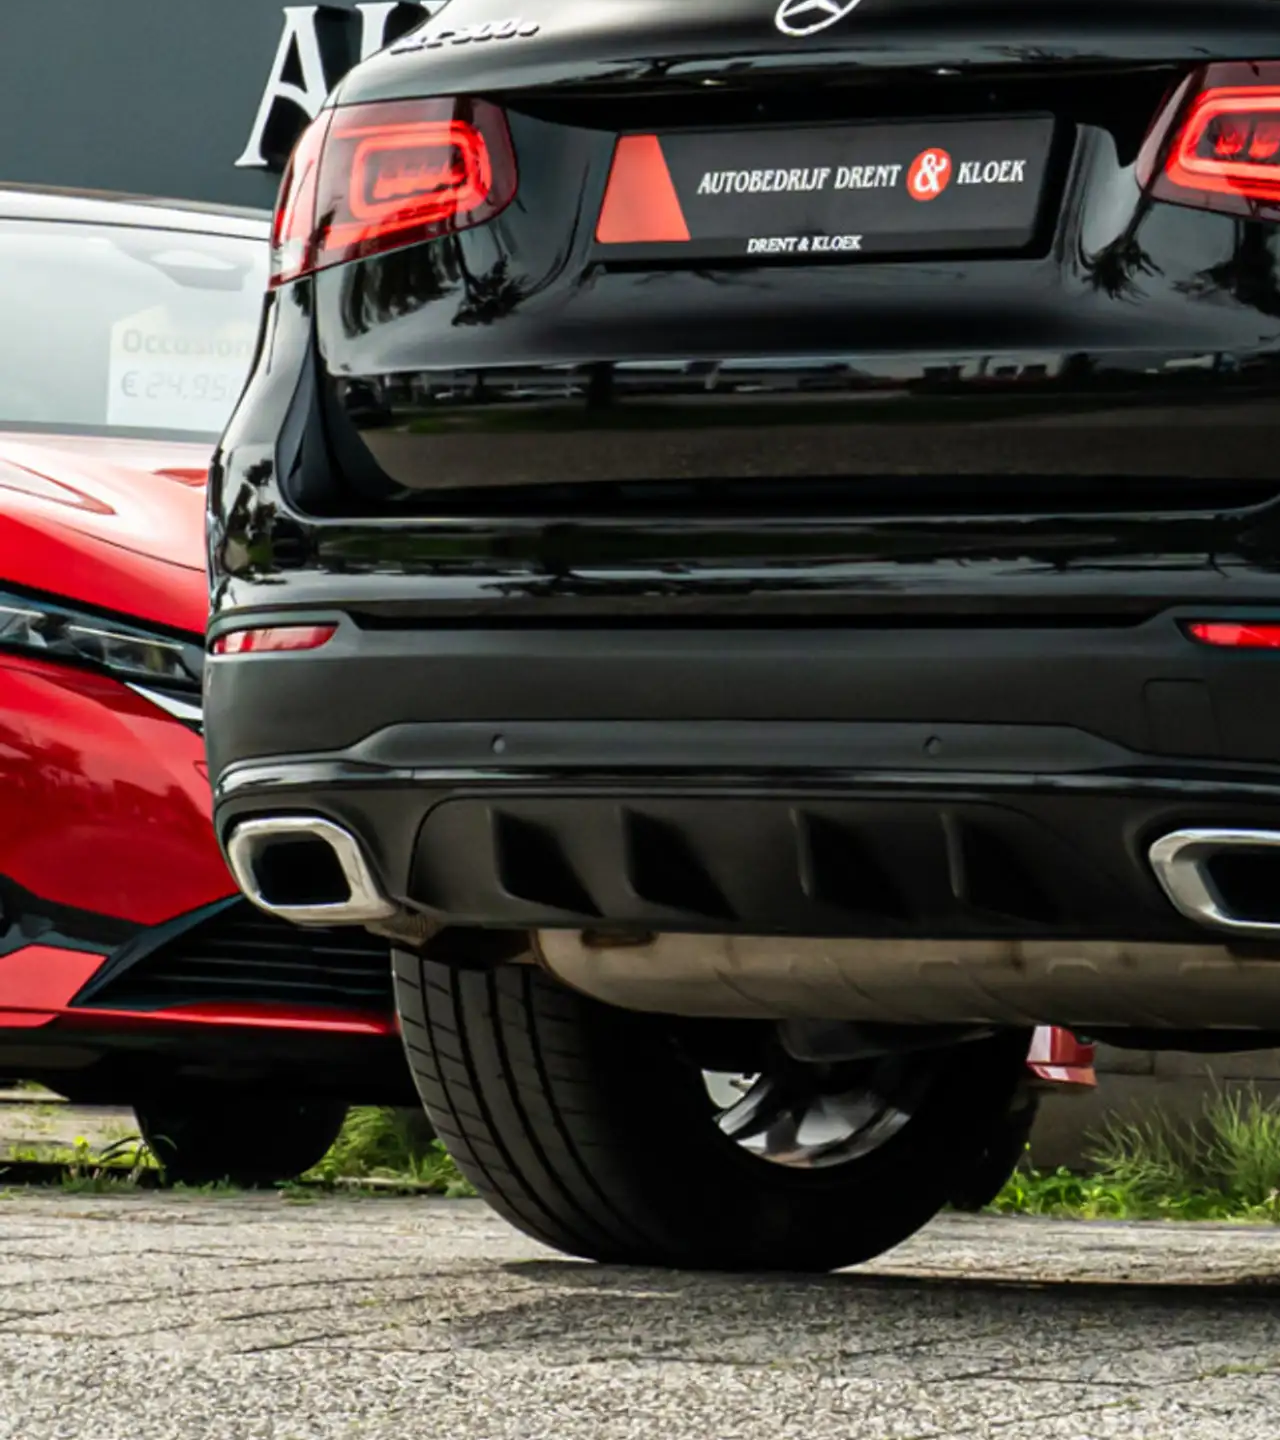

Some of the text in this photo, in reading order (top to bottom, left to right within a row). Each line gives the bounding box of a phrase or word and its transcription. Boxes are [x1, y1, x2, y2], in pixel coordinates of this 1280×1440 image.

[697, 153, 1026, 194] AUTOBEDRIJF DRENT & KLOEK
[746, 235, 862, 253] DRENT & KLOEK
